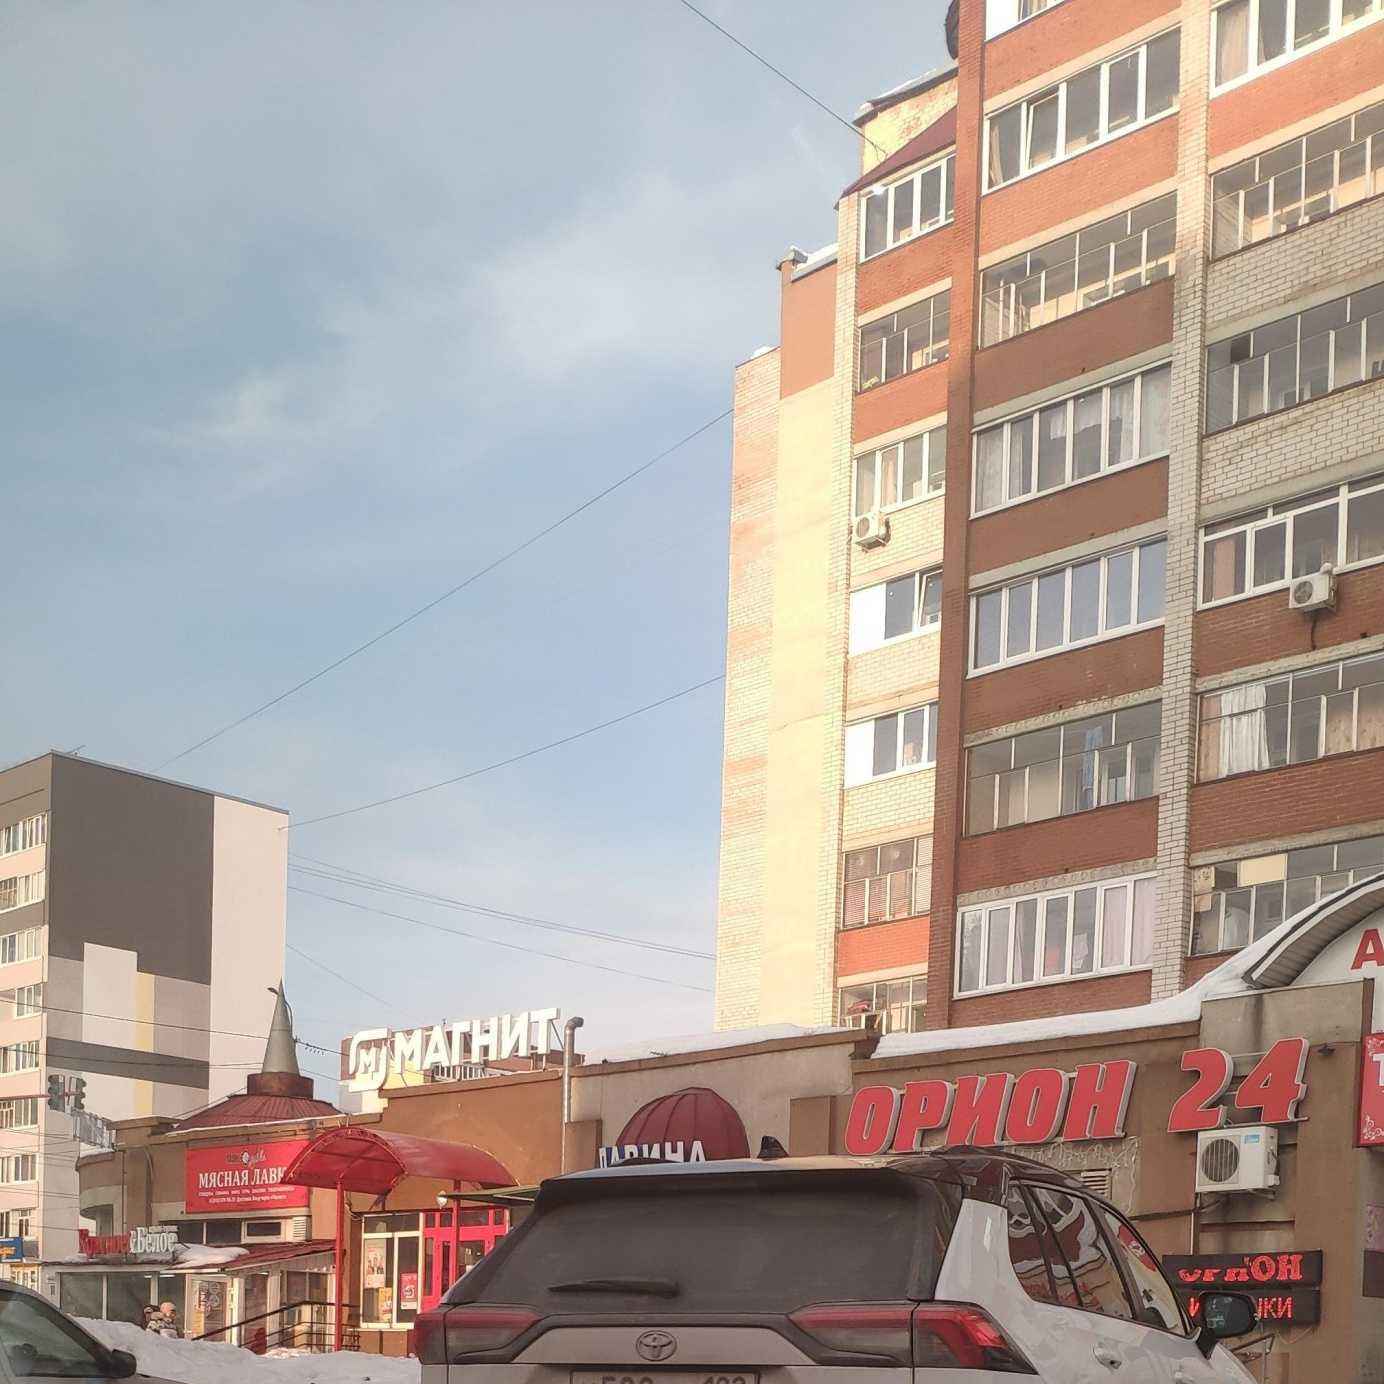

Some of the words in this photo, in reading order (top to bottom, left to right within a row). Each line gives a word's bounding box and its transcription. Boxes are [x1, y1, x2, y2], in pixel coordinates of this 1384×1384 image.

[394, 1008, 559, 1074] МАГНИТ
[844, 1060, 1137, 1155] ОРИОН
[1168, 1038, 1309, 1132] 24
[199, 1169, 250, 1189] МЯСНАЯ
[251, 1166, 287, 1185] ЛАВК
